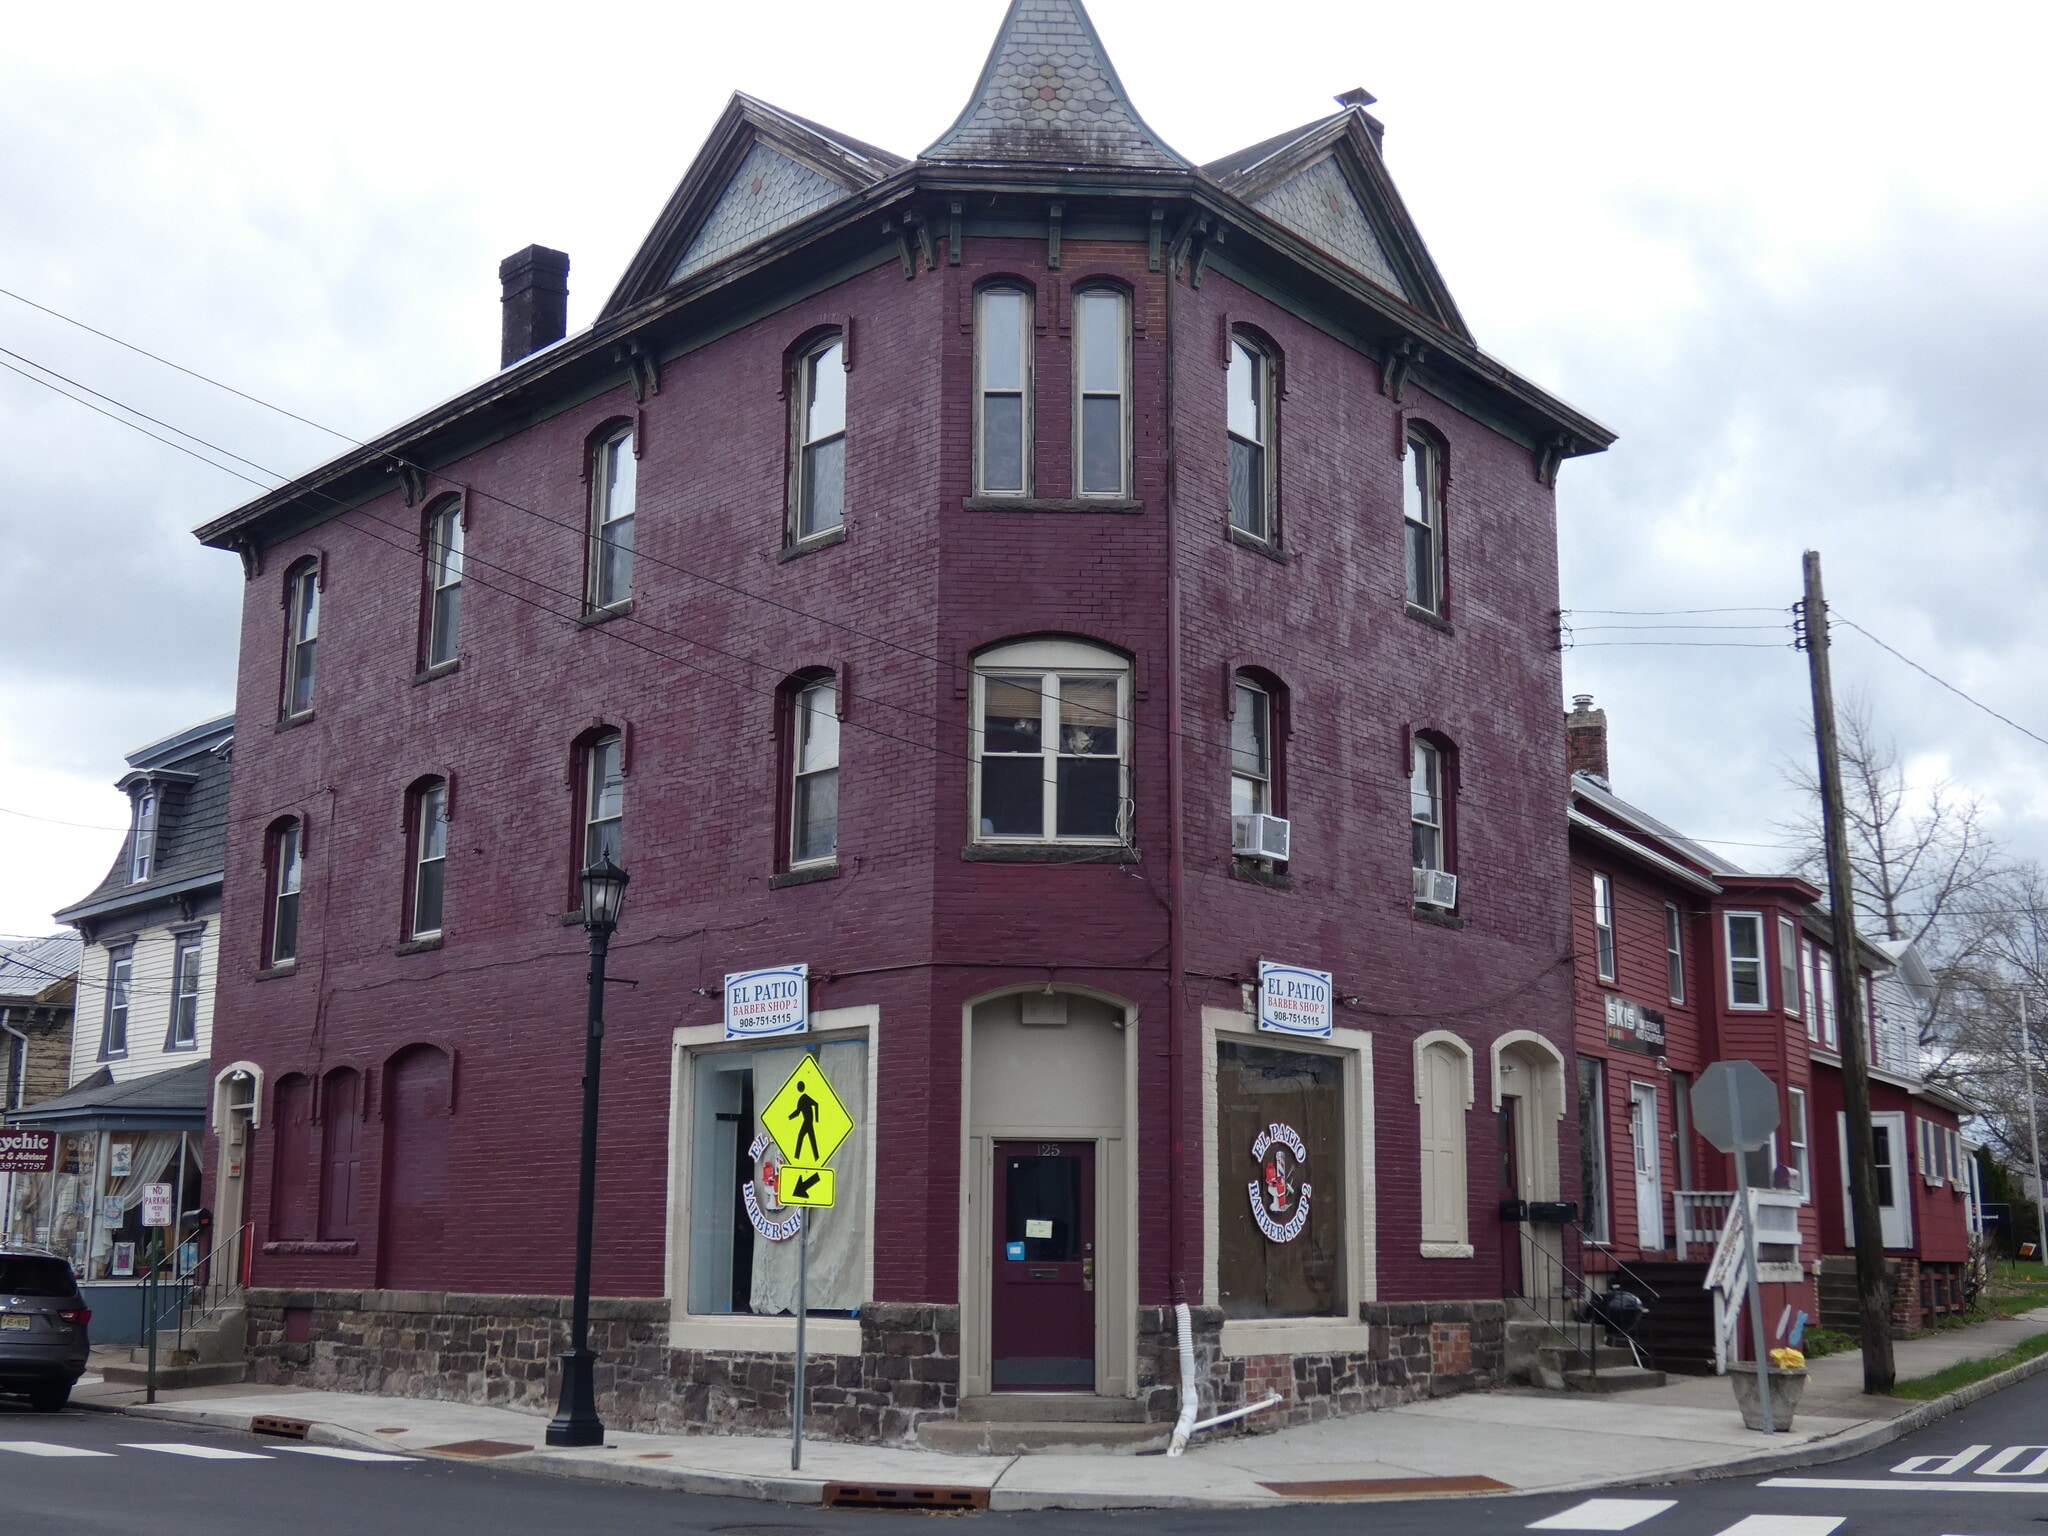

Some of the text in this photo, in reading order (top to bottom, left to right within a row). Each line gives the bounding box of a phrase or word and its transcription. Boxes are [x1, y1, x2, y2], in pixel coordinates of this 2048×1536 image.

[733, 980, 797, 1004] EL PATIO
[1268, 978, 1325, 1002] EL PATIO
[733, 999, 798, 1016] BARBER SHOP 2
[1268, 997, 1325, 1014] BARBER SHOP 2
[739, 1013, 791, 1028] 908-751-5115
[1274, 1011, 1320, 1026] 908-751-5115
[1608, 1003, 1634, 1029] SKIS
[0, 1132, 49, 1152] ychic
[749, 1133, 769, 1162] EL
[1036, 1144, 1060, 1156] 125
[1252, 1123, 1306, 1163] EL PATIO
[15, 1152, 48, 1161] Advisor
[152, 1186, 163, 1195] NO
[144, 1197, 170, 1205] PARKING
[743, 1181, 781, 1240] BARBER
[1248, 1181, 1312, 1242] BARBER SHOP 2
